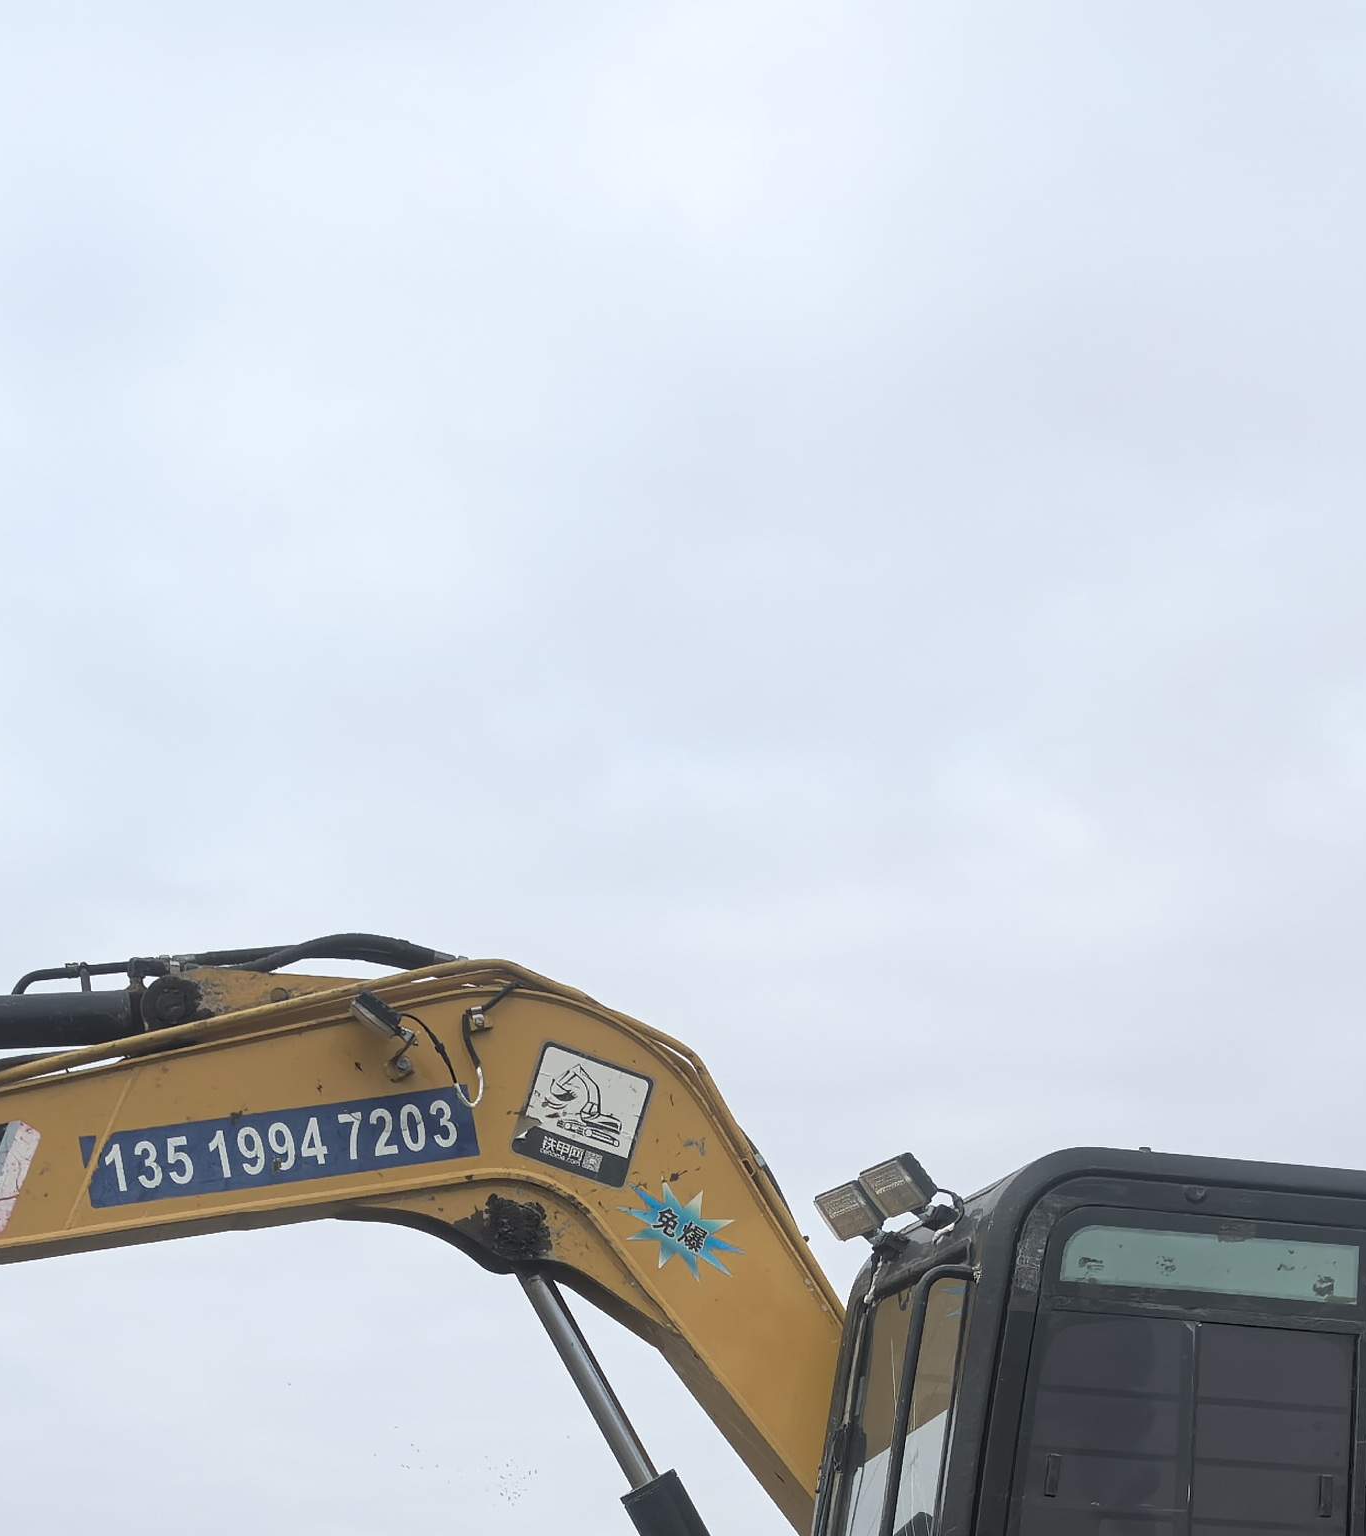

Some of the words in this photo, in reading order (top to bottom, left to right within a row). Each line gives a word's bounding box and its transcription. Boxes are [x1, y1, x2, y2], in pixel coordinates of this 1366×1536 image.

[104, 1135, 195, 1192] 135
[208, 1116, 328, 1179] 1994
[337, 1099, 458, 1161] 7203
